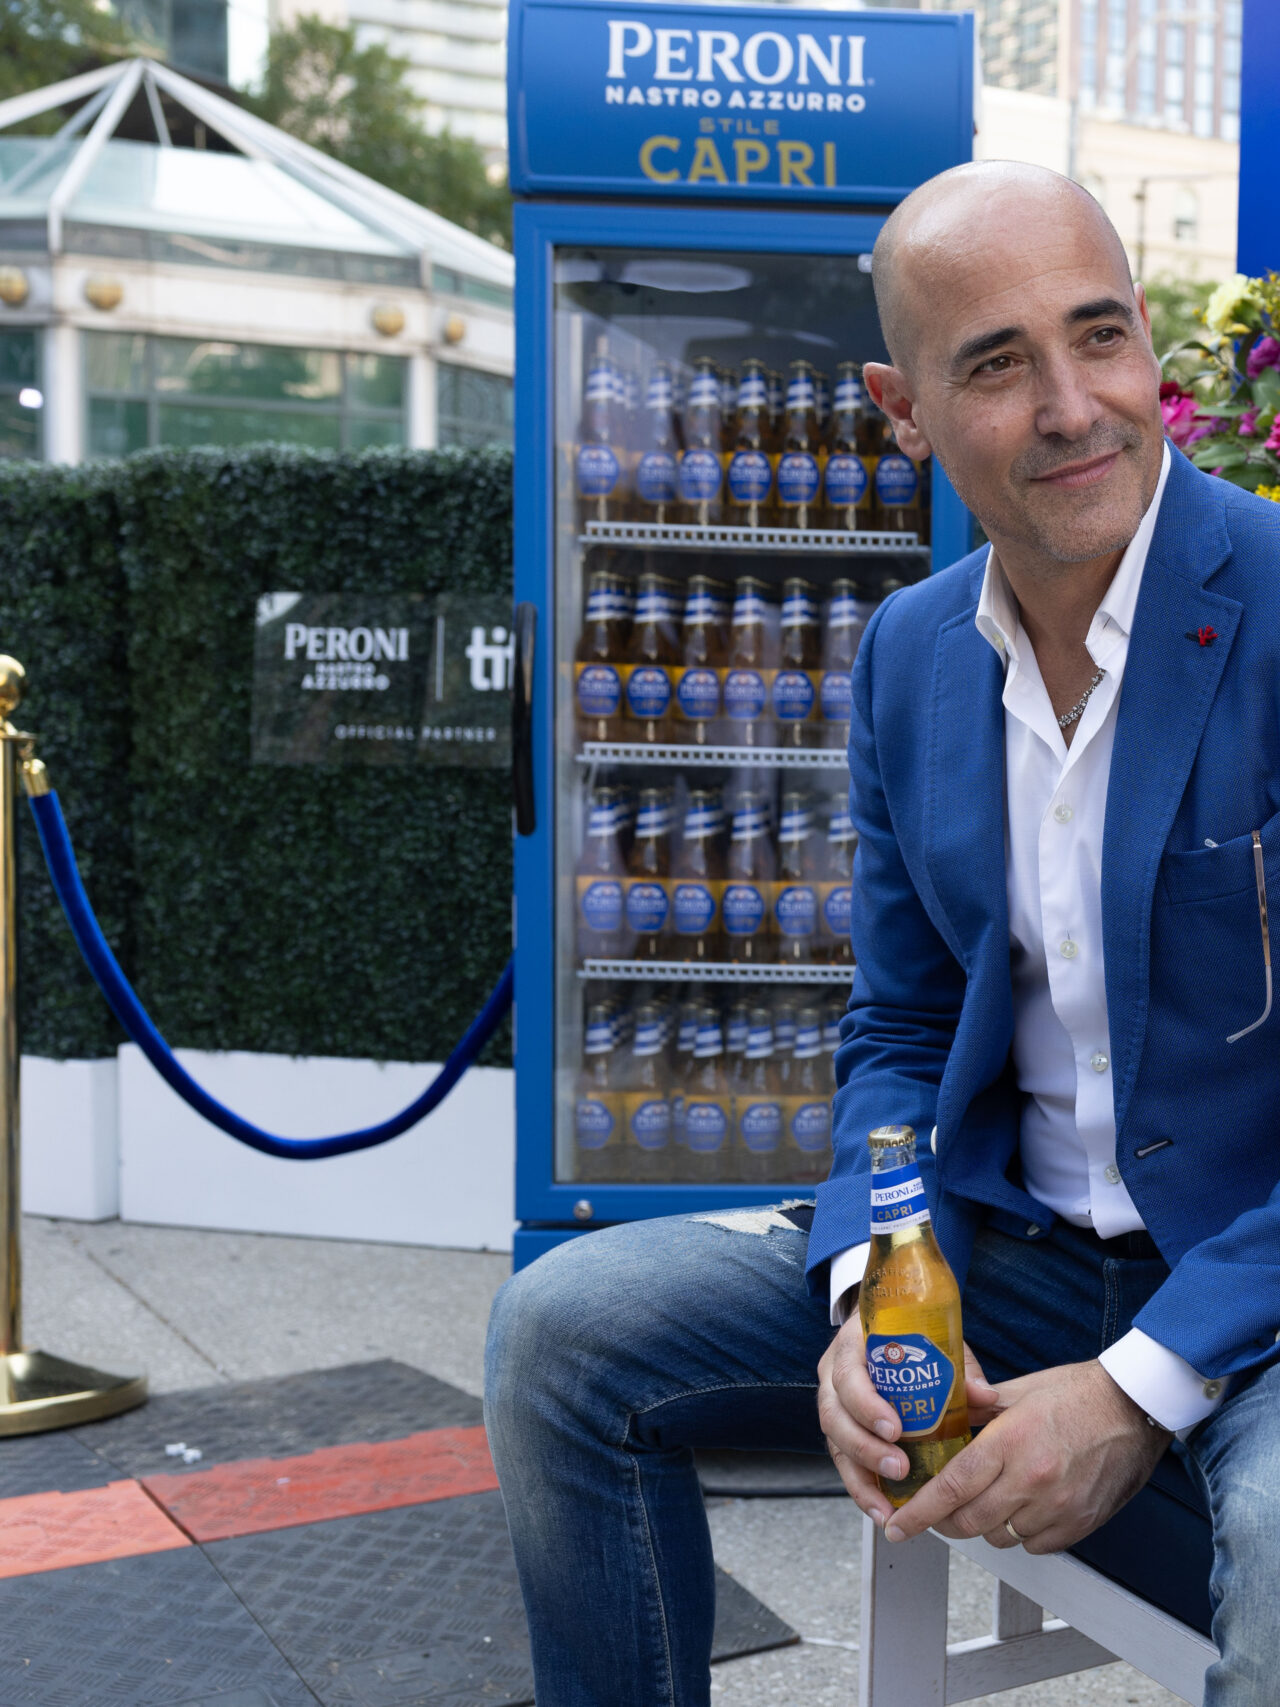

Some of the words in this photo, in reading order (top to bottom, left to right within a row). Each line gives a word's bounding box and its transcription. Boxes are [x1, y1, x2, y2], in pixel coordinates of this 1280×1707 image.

[606, 20, 866, 86] PERONI
[606, 85, 721, 108] NASTRO
[728, 90, 866, 112] AZZURRO
[699, 117, 781, 136] STILE
[639, 135, 836, 188] CAPRI
[284, 623, 410, 661] PERONI
[465, 626, 516, 691] ti
[335, 724, 415, 740] OFFICIAL
[421, 726, 497, 742] PARTNER
[875, 1187, 910, 1202] PERONI
[877, 1203, 913, 1221] CAPRI
[867, 1361, 940, 1385] PERONI
[874, 1383, 894, 1392] STRO
[896, 1379, 941, 1392] AZZURRO
[889, 1397, 936, 1416] PRI
